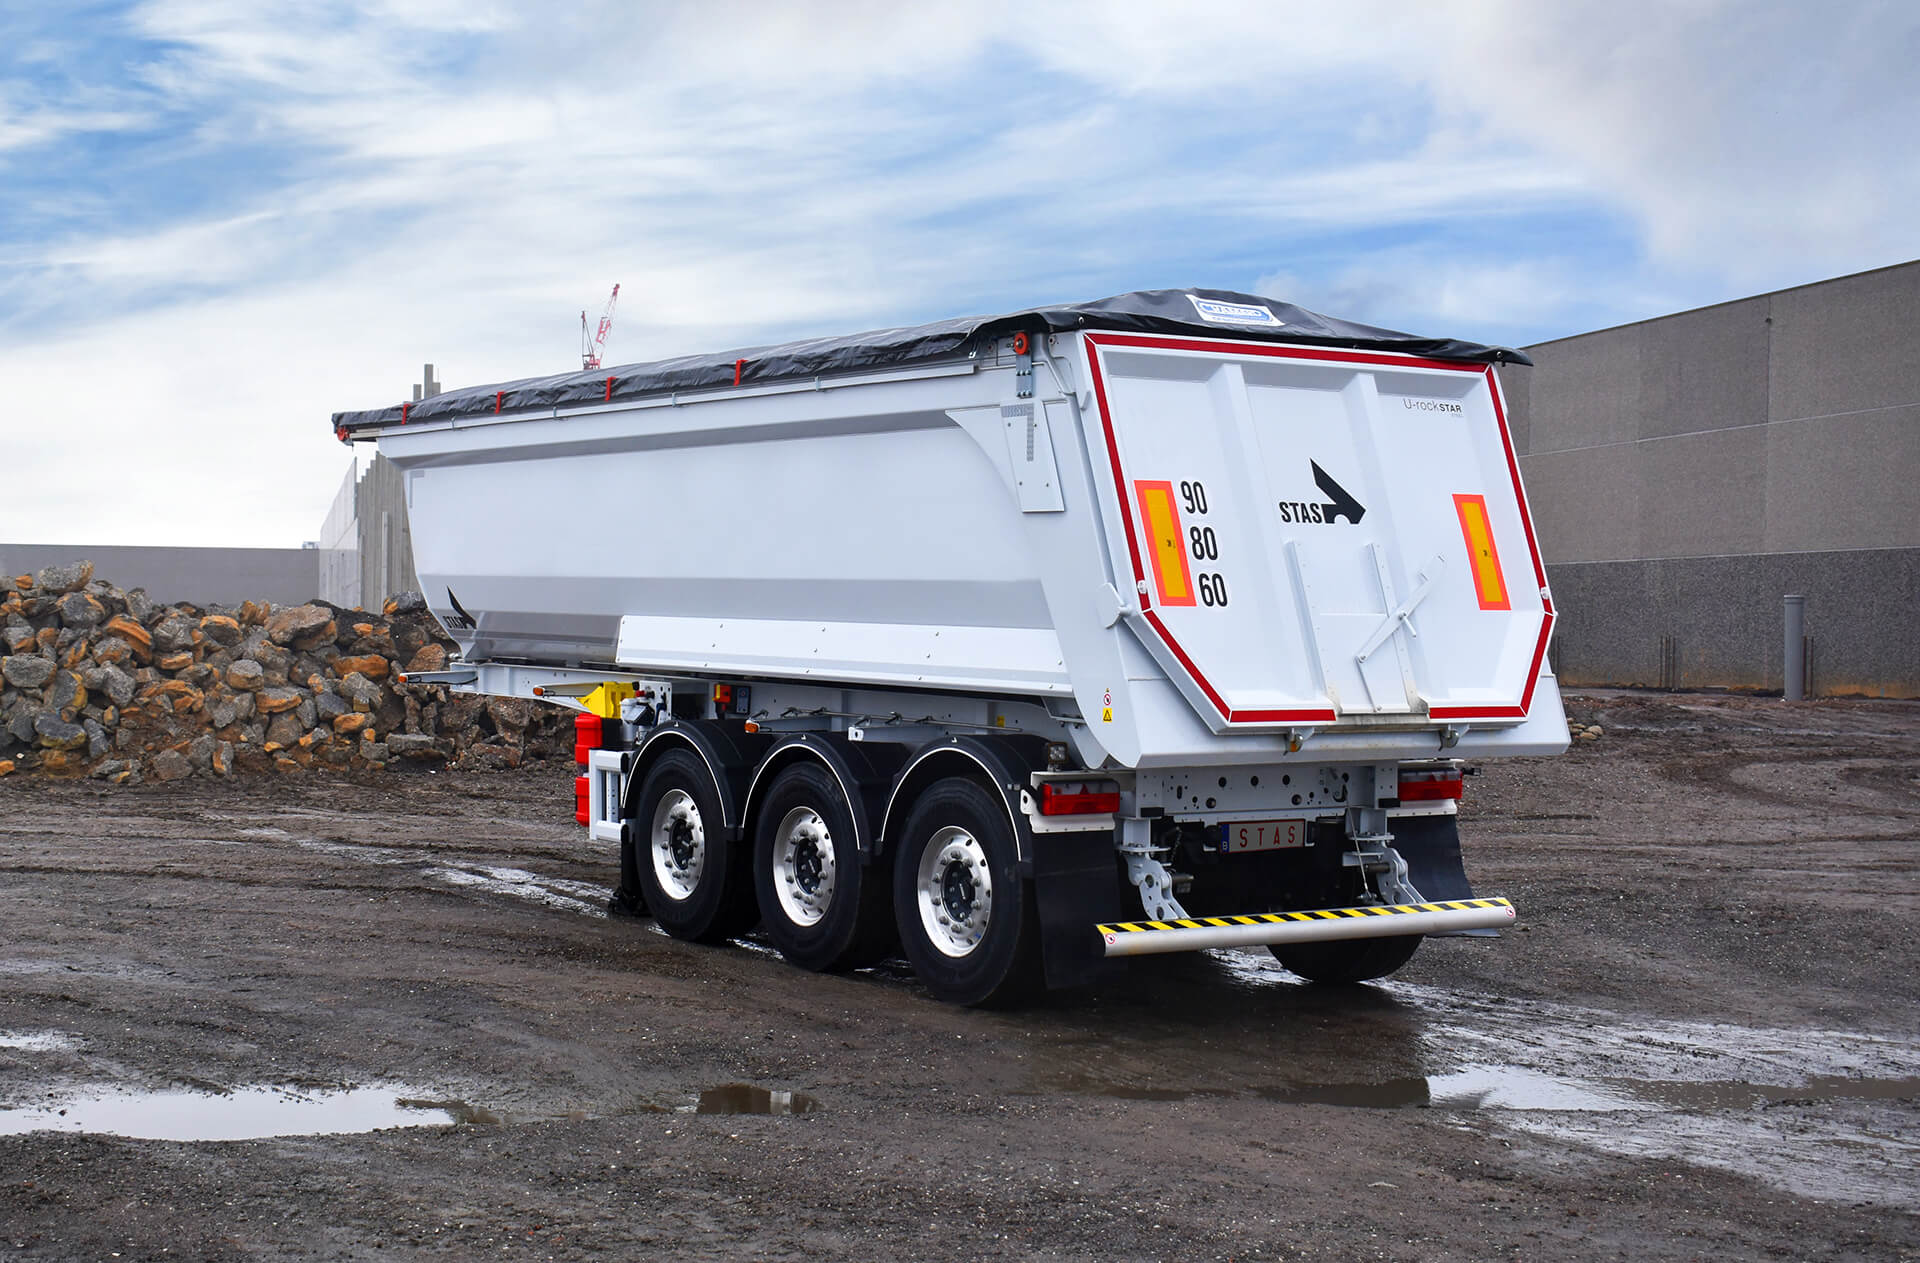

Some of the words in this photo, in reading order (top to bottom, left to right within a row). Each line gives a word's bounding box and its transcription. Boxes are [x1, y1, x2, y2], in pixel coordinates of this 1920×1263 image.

[1181, 481, 1208, 514] 90
[1279, 501, 1322, 523] STAS
[1190, 526, 1218, 560] 80
[1199, 573, 1228, 607] 60
